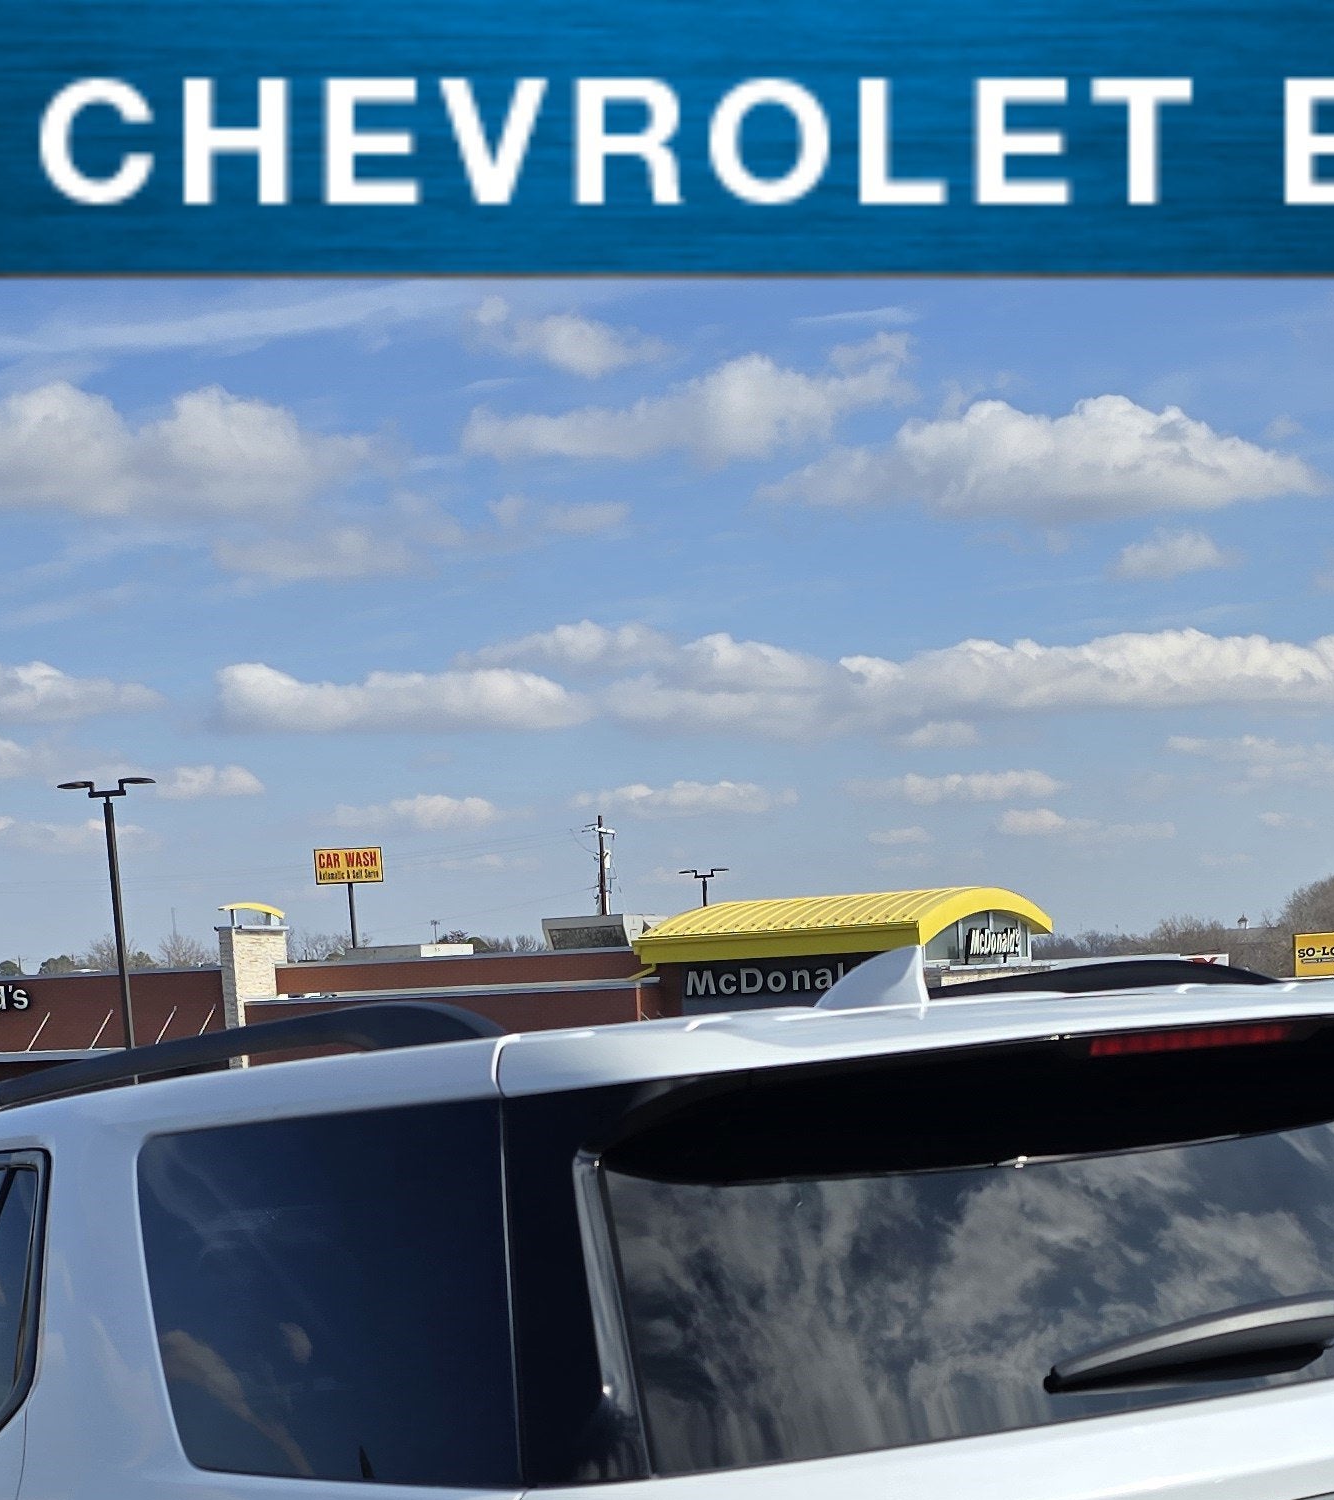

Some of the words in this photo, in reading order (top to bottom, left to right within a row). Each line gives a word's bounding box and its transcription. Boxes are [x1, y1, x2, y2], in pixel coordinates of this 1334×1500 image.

[318, 852, 341, 869] CAR
[344, 851, 378, 867] WASH
[968, 927, 1021, 956] McDonald's
[685, 961, 853, 997] McDonal
